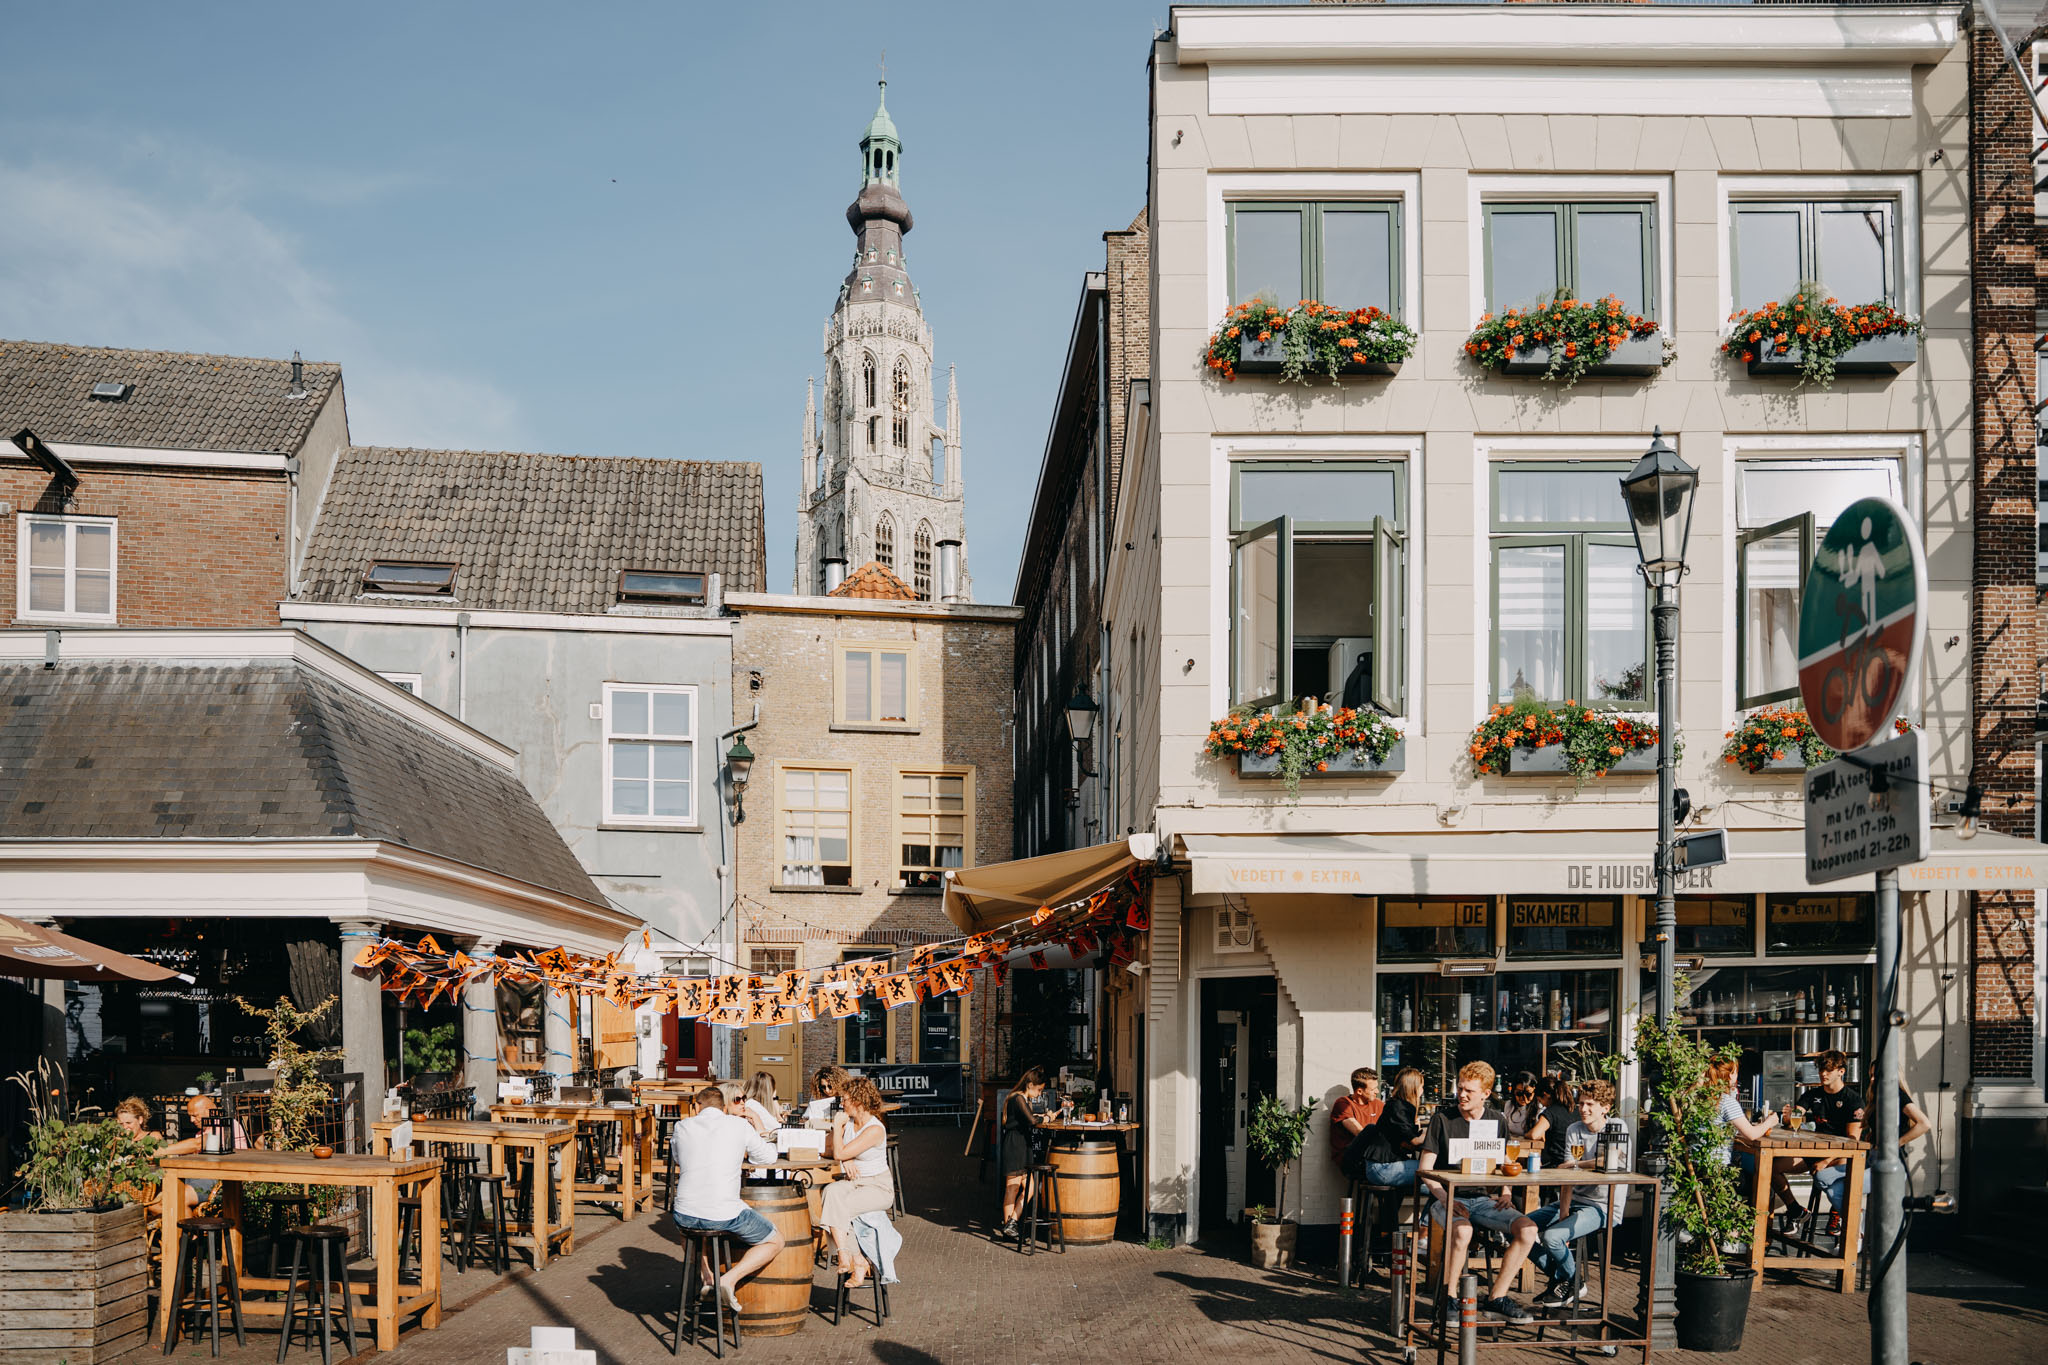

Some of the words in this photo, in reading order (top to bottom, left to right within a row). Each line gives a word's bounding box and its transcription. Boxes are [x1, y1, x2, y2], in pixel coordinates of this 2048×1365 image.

[1826, 812, 1842, 827] ma
[1845, 802, 1866, 821] t/m
[1822, 830, 1842, 849] 7-11
[1844, 829, 1857, 843] en
[1860, 814, 1896, 837] 17-19h
[1811, 845, 1866, 872] koopavond
[1869, 833, 1911, 858] 21-22h
[1231, 869, 1285, 882] VEDETT
[1311, 870, 1362, 883] EXTRA
[1567, 865, 1593, 889] DE
[1598, 865, 1713, 889] HUISKMER
[1909, 866, 1960, 880] VEDETT
[1984, 865, 2035, 879] EXTRA
[1463, 904, 1484, 924] DE
[1794, 904, 1832, 915] EXTRA
[1474, 1140, 1501, 1150] DRINKS
